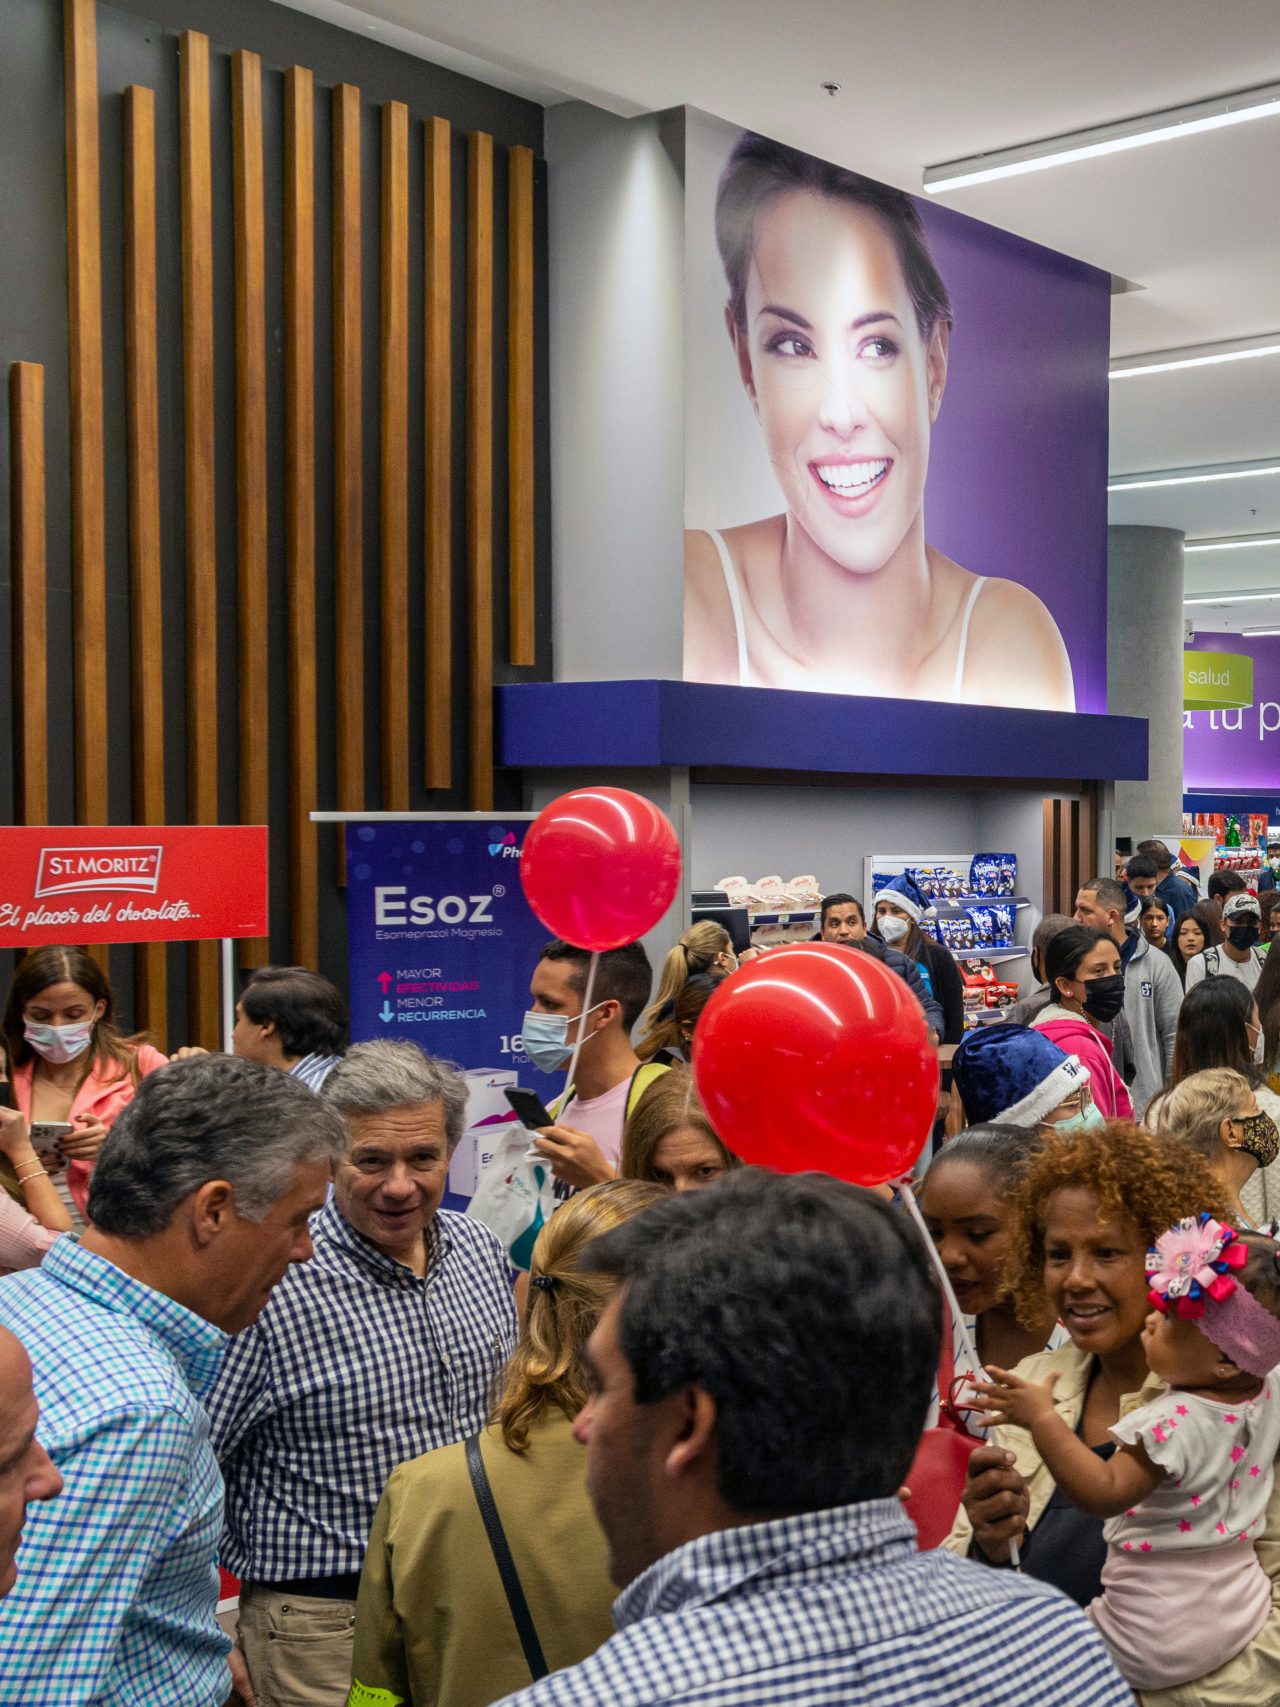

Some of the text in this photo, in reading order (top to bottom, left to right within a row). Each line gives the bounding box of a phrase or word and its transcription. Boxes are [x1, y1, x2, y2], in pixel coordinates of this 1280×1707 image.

[1188, 668, 1230, 686] salud
[0, 903, 21, 928] El
[21, 904, 80, 932] placer
[82, 902, 113, 925] del
[375, 928, 503, 940] Esomeprazol Magnesio
[396, 968, 442, 979] MAYOR
[397, 981, 479, 993] EFECTIVIDAD
[398, 997, 443, 1009] MENOR
[398, 1009, 487, 1022] RECURRENCIA
[500, 1034, 525, 1053] 16
